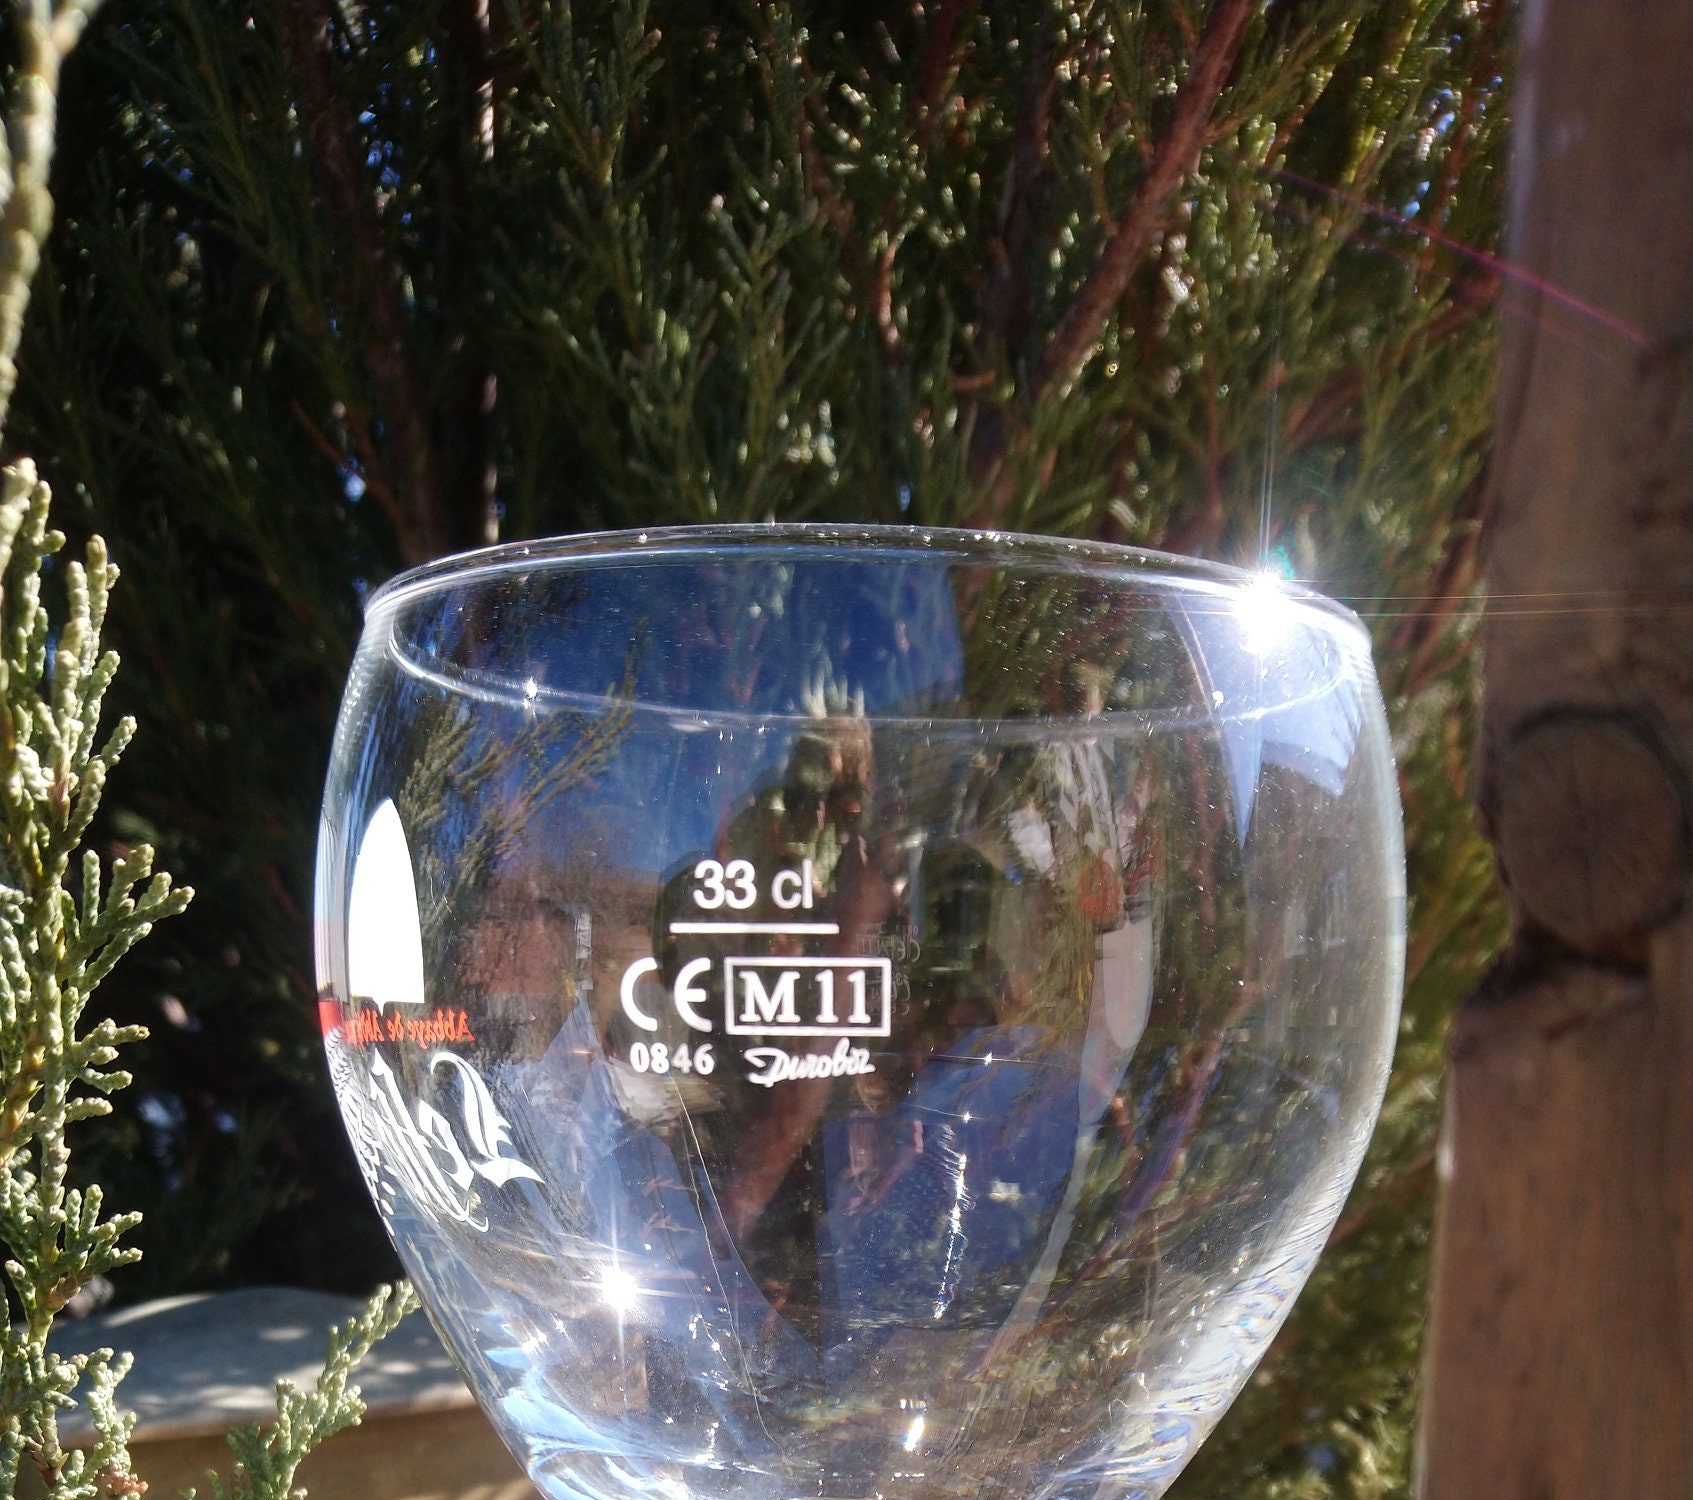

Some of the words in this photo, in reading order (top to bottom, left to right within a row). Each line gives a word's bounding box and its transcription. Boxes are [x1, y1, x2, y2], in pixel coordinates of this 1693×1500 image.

[693, 859, 757, 909] 33
[771, 858, 814, 909] cl
[629, 1041, 716, 1076] 0846
